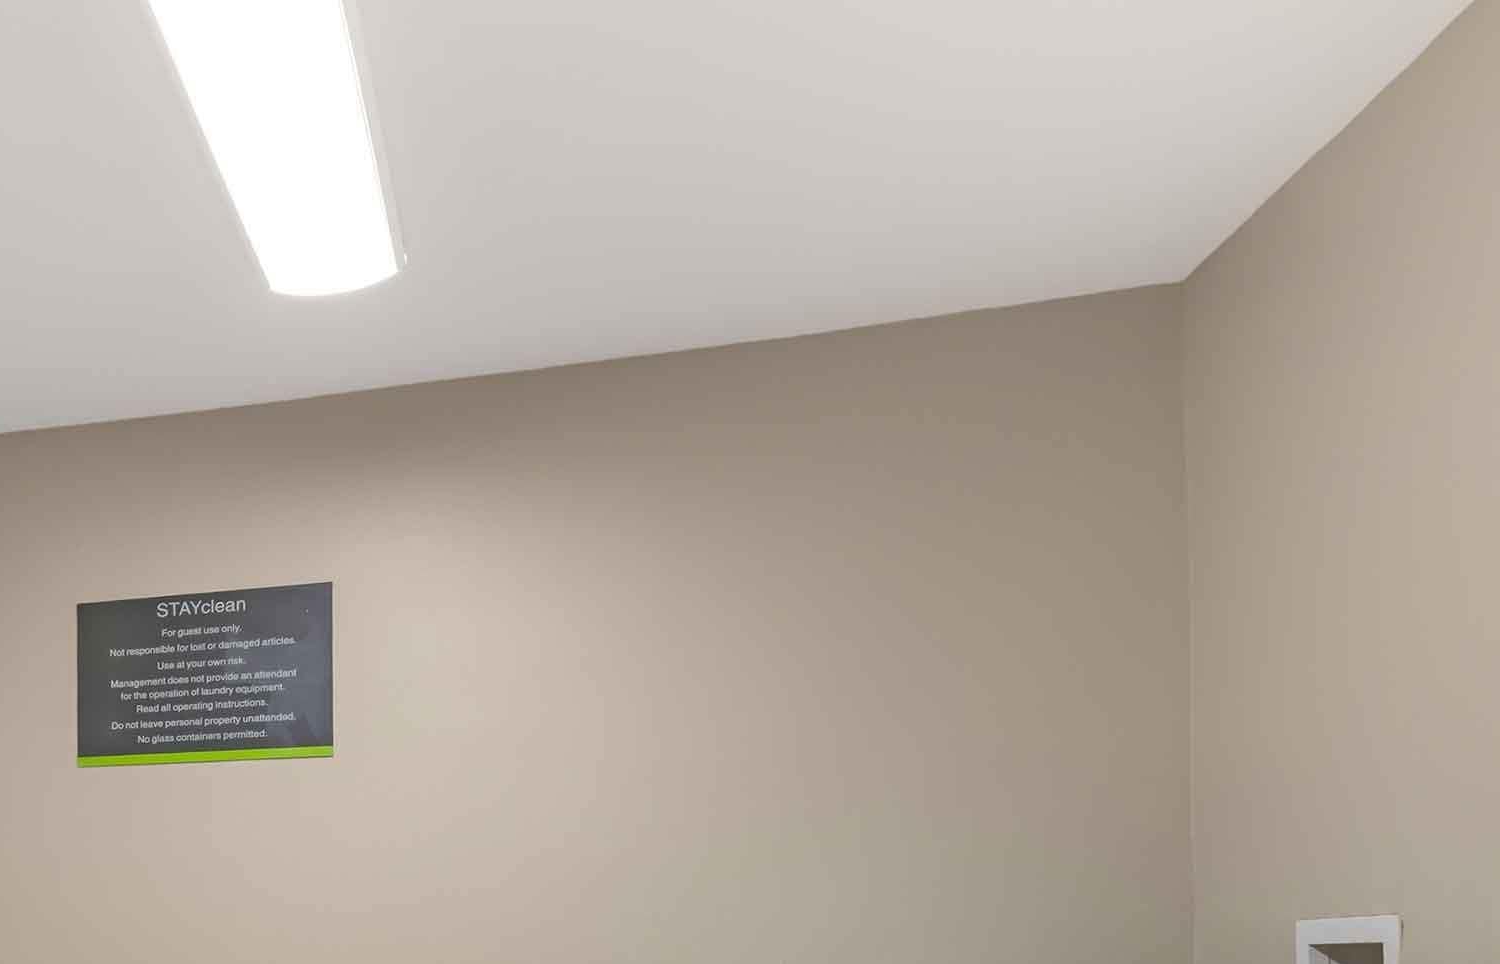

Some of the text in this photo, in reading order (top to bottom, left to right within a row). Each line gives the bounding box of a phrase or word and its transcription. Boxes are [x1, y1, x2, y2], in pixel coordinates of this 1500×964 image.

[156, 599, 246, 618] STAYclean
[161, 628, 177, 637] For
[178, 627, 202, 638] guest
[203, 626, 220, 634] use
[109, 635, 297, 657] Not responsible for lost or damaged articles.
[157, 656, 246, 670] Use at your own risk.
[110, 668, 297, 689] Management does not provide an attendant
[120, 683, 285, 701] for the operation of laundry equipment.
[136, 699, 268, 713] Read all operating instructions.
[110, 711, 297, 730] Do not leave personal property unattended.
[137, 735, 151, 744] No
[151, 734, 175, 744] glass
[176, 732, 221, 742] containers
